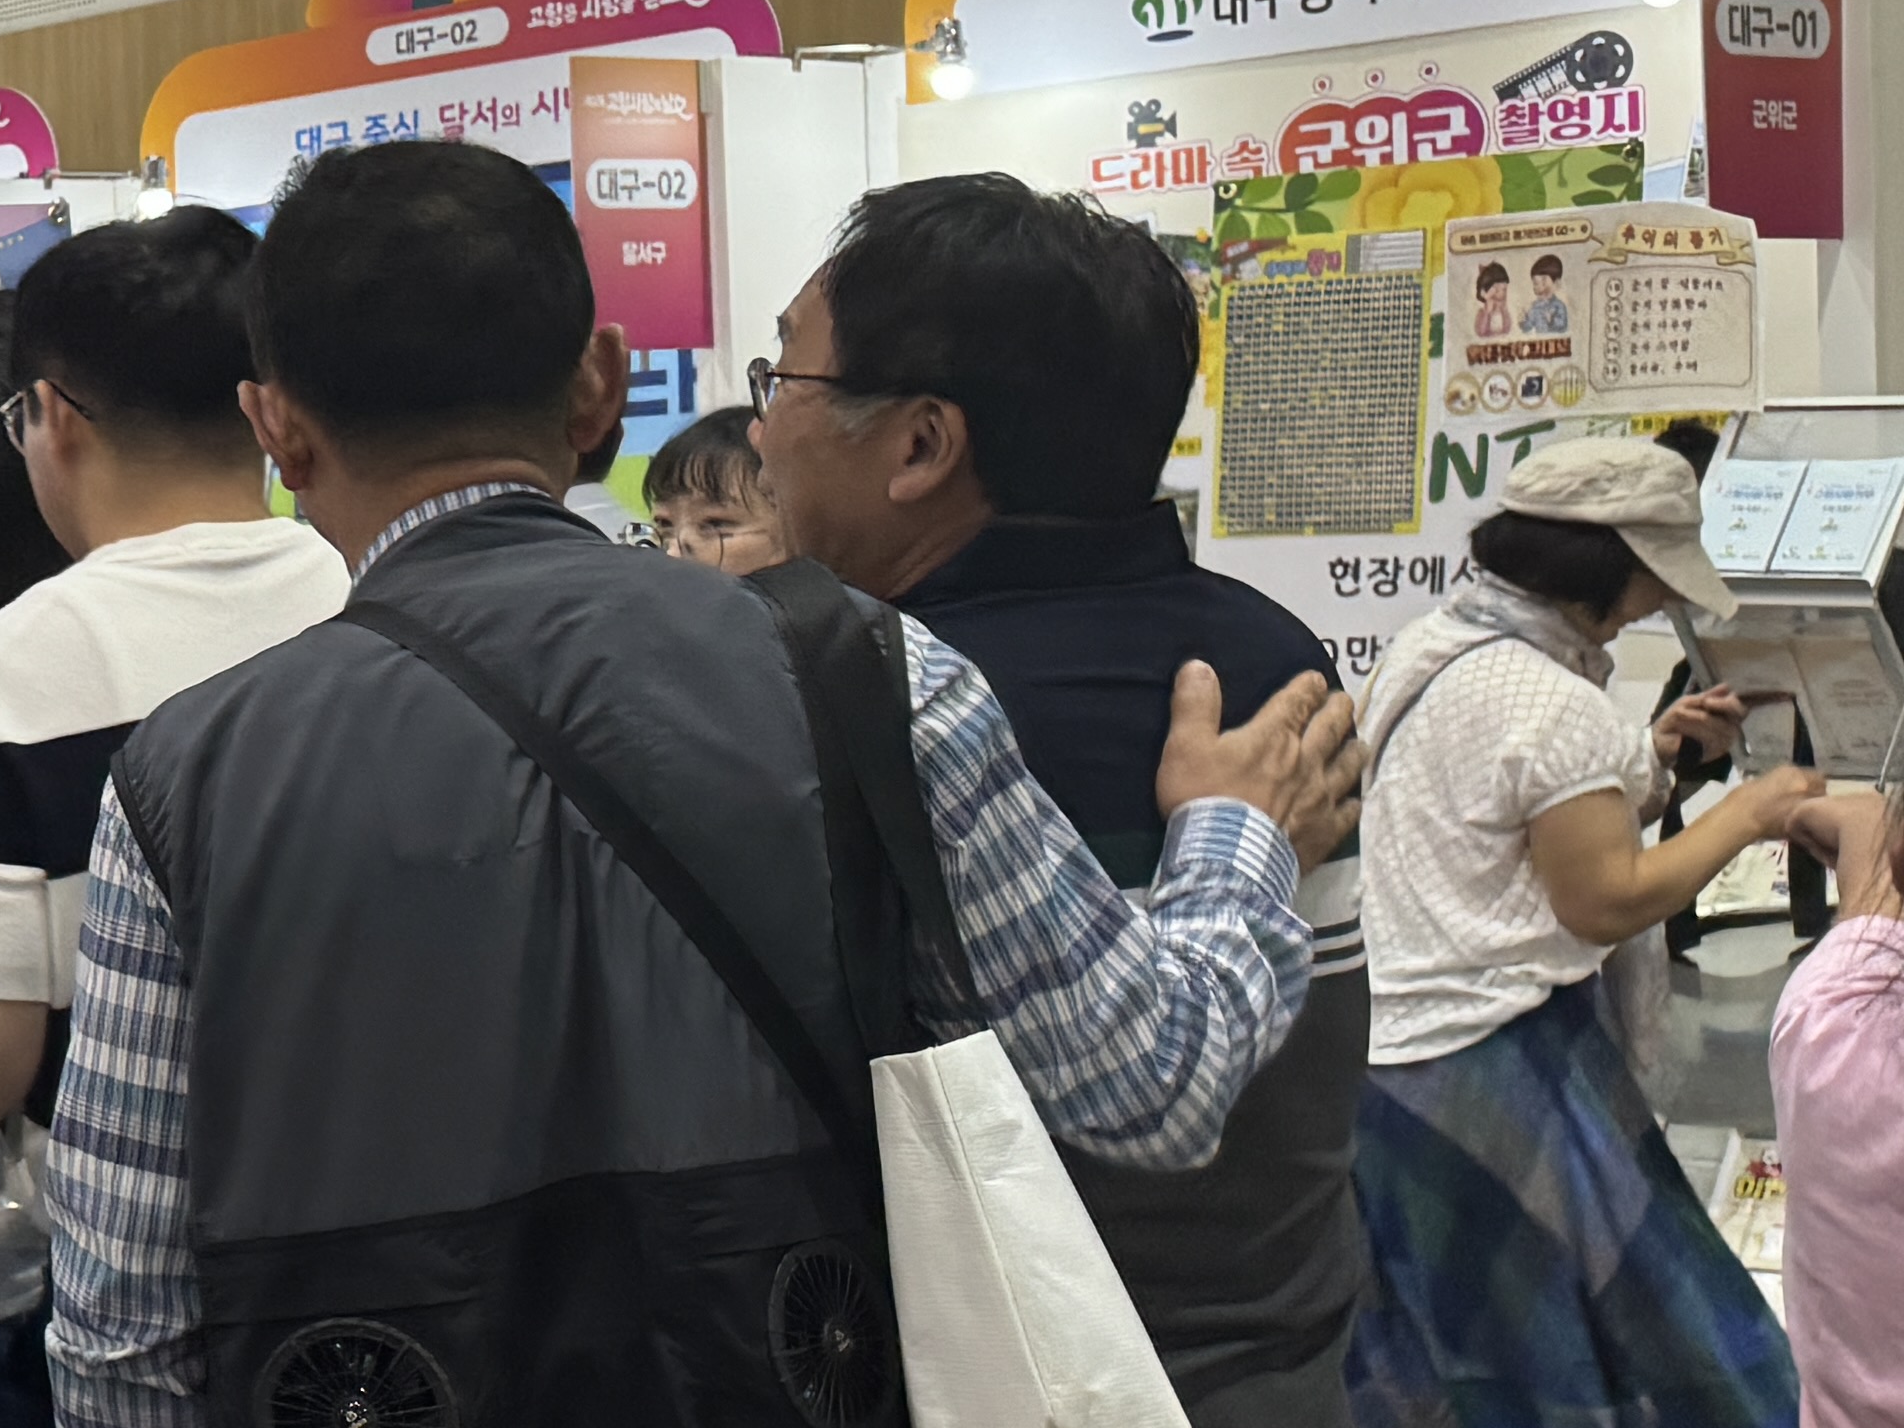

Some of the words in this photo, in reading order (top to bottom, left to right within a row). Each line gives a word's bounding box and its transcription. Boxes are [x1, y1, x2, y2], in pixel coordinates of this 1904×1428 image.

[527, 2, 577, 29] 고향은
[1728, 4, 1818, 49] 대구-01
[395, 20, 478, 55] 대구-02
[296, 121, 353, 156] 대구
[362, 108, 420, 143] 중심
[439, 96, 521, 138] 달서의
[1752, 99, 1797, 130] 군위군
[1092, 144, 1213, 194] 드라마
[1295, 104, 1471, 169] 군위군
[596, 168, 687, 201] 대구-02
